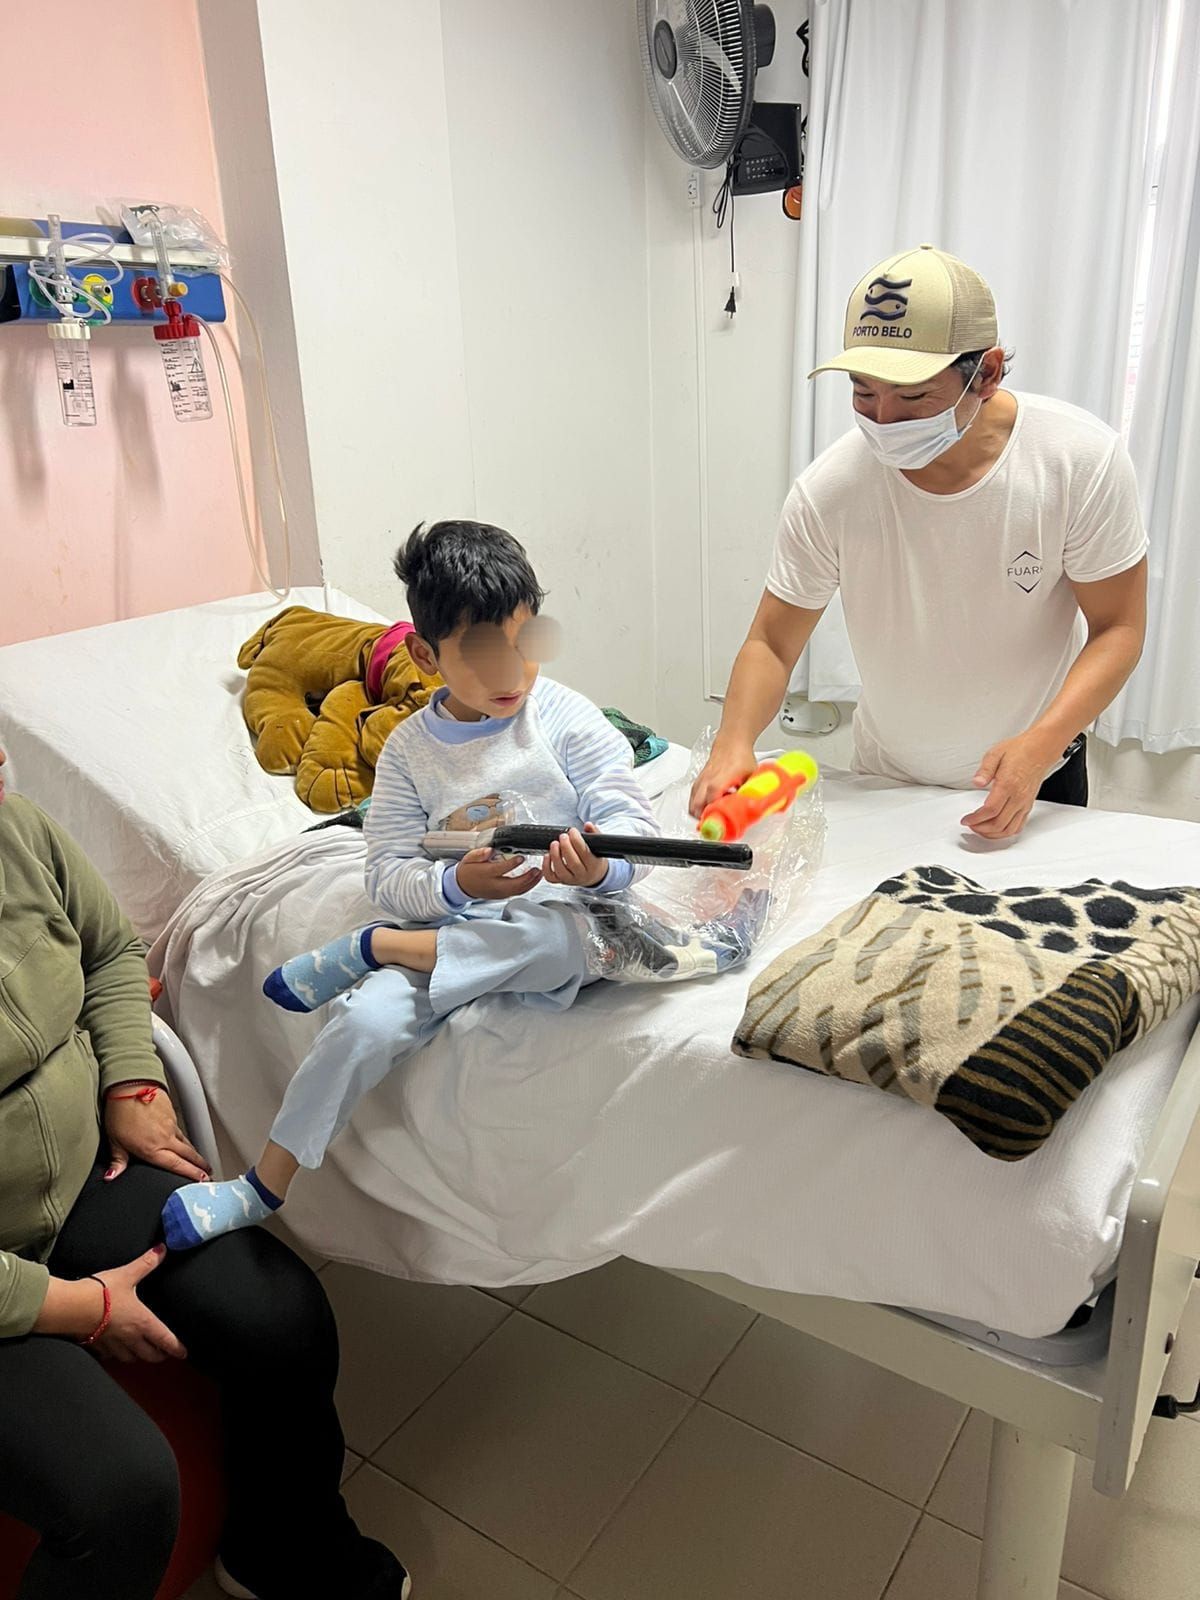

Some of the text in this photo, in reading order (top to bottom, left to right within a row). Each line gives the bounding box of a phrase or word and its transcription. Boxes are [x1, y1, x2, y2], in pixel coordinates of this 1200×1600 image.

[853, 326, 912, 338] PORTO BELO
[1007, 566, 1043, 576] FUAR
